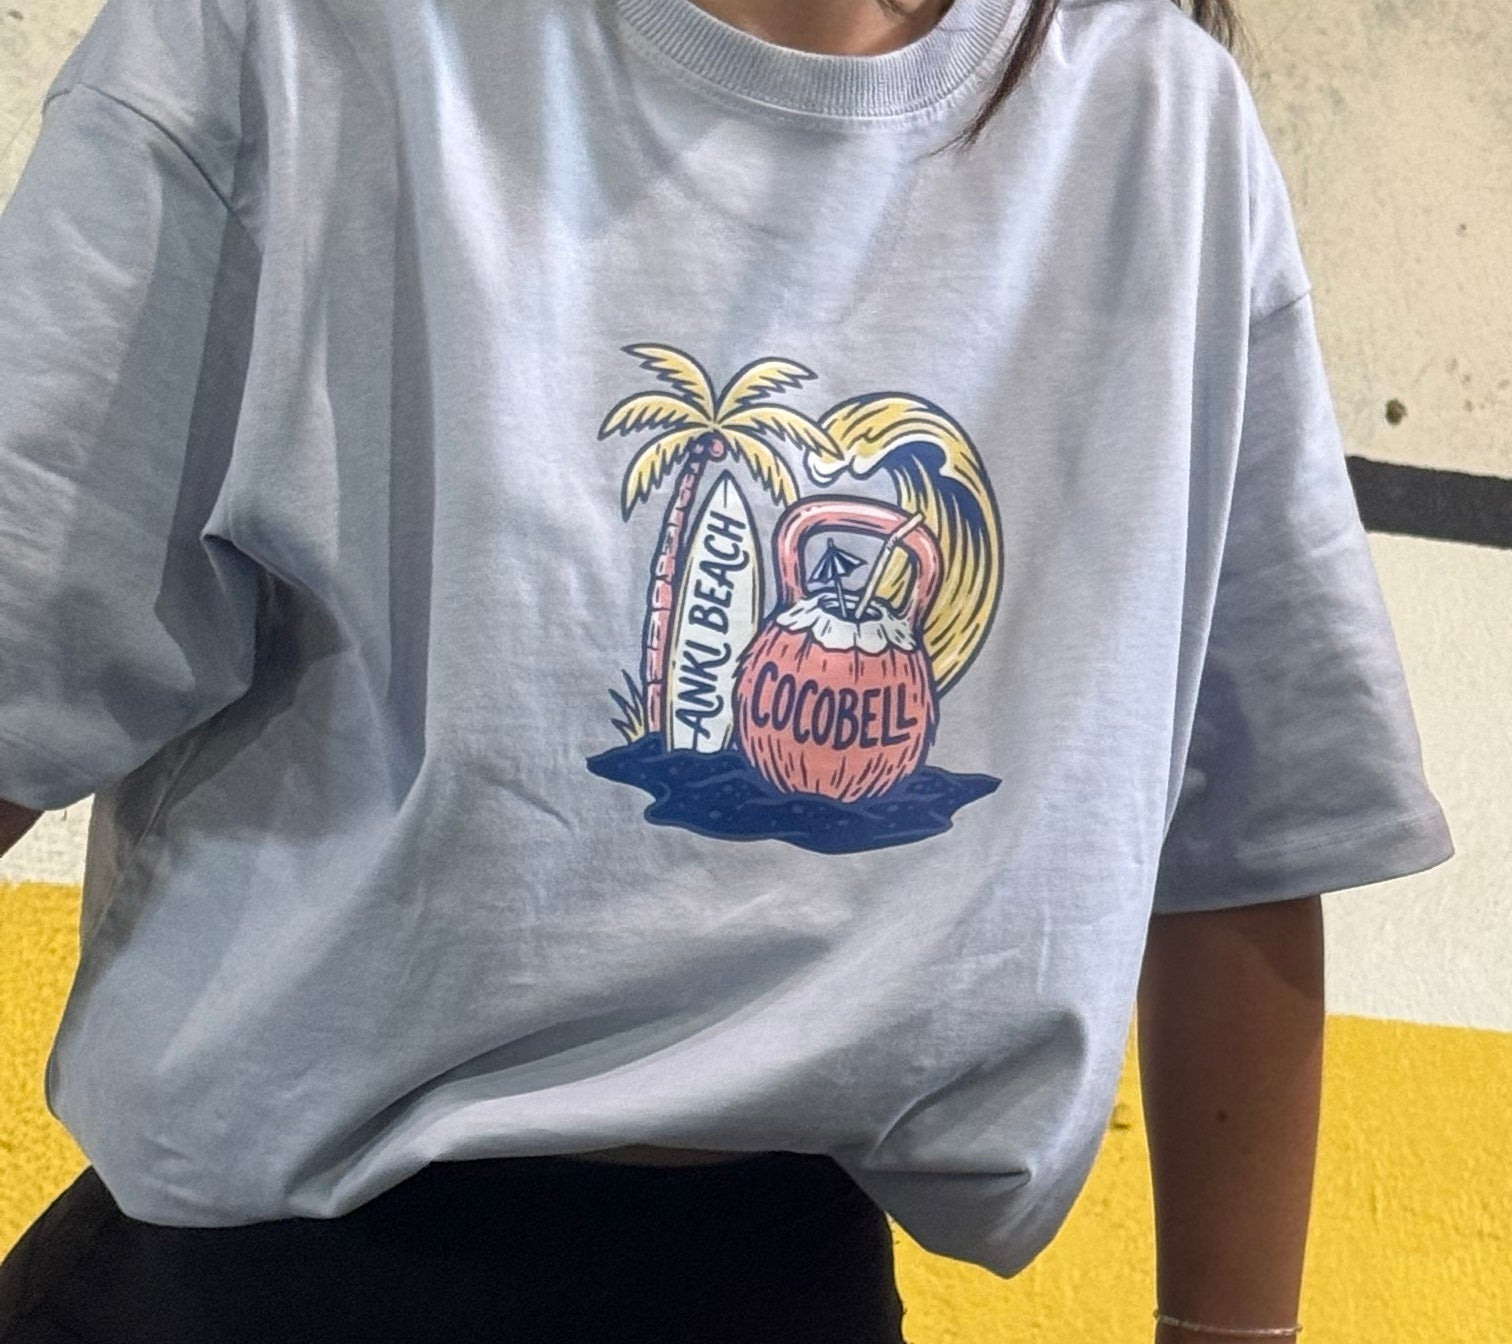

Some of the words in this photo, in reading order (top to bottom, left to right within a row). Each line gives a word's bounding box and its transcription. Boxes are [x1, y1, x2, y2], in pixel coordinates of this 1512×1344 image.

[688, 510, 749, 635] BEACH
[675, 639, 732, 739] ANKI
[751, 661, 918, 749] COCOBELL
